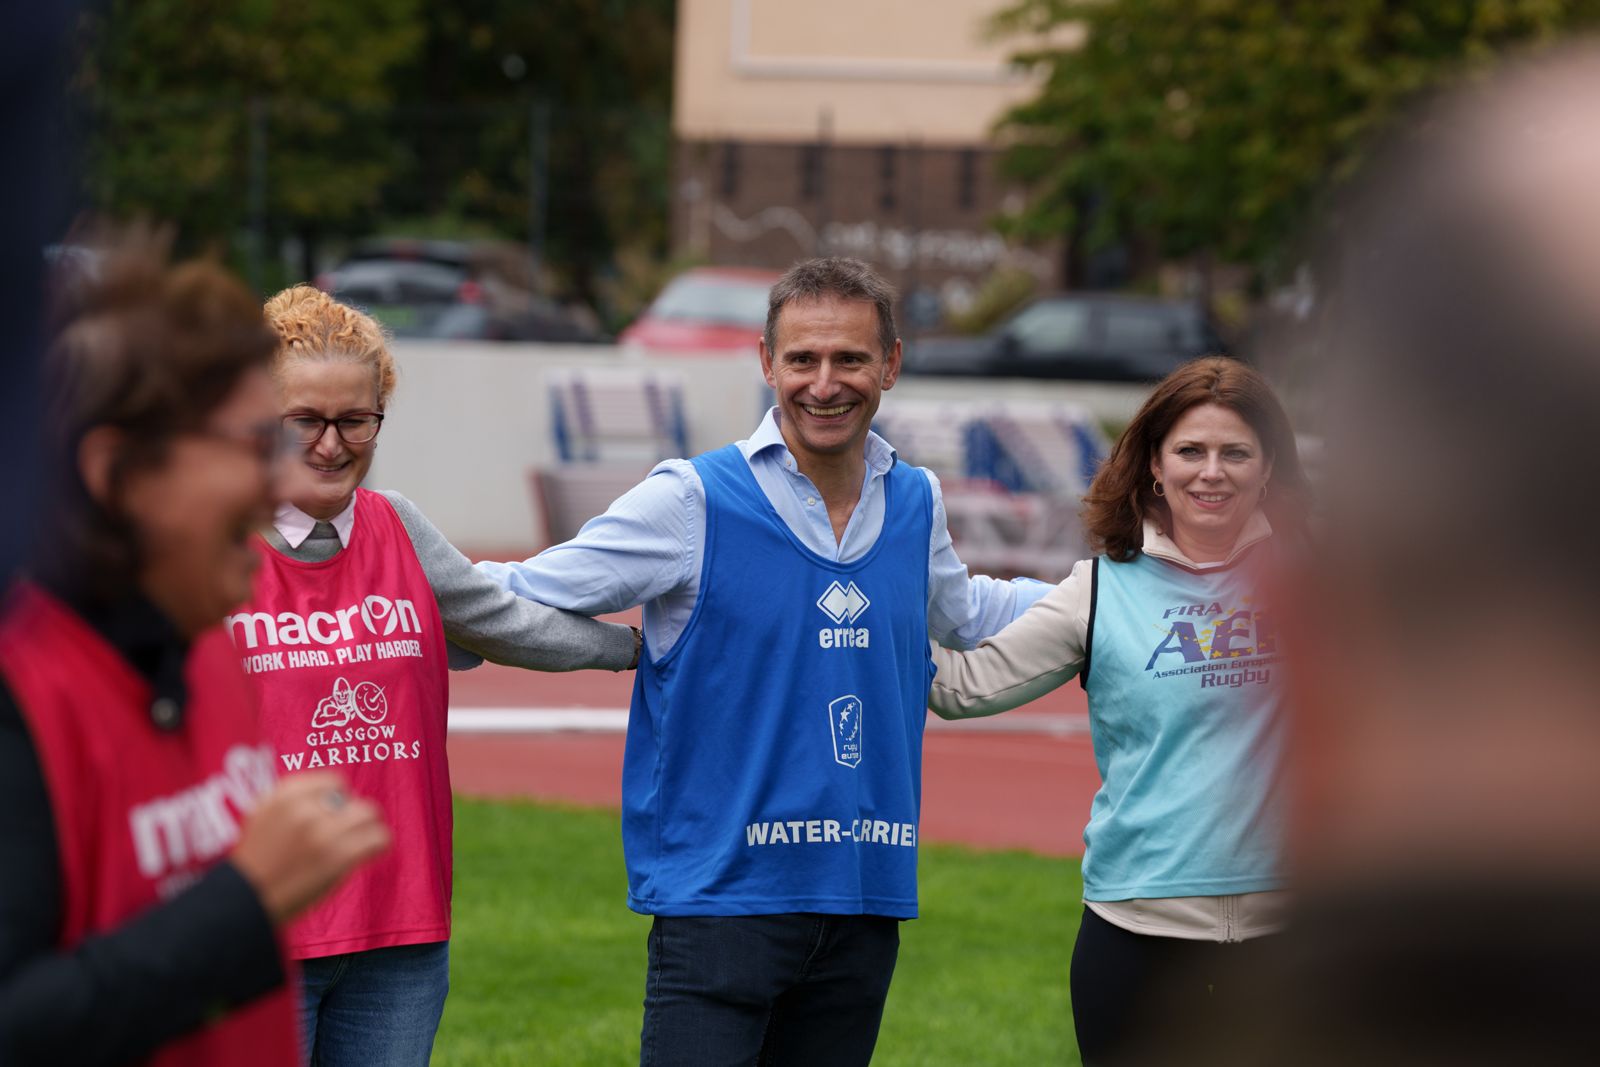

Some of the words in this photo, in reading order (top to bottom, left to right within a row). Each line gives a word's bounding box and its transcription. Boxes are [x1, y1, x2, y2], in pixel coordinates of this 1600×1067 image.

[225, 594, 422, 649] macron
[1162, 602, 1223, 619] FIRA
[287, 650, 335, 668] HARD.
[336, 643, 372, 665] PLAY
[1153, 663, 1227, 680] Association
[1200, 668, 1270, 688] Rugby
[306, 724, 395, 746] GLASGOW
[281, 740, 420, 771] WARRIORS
